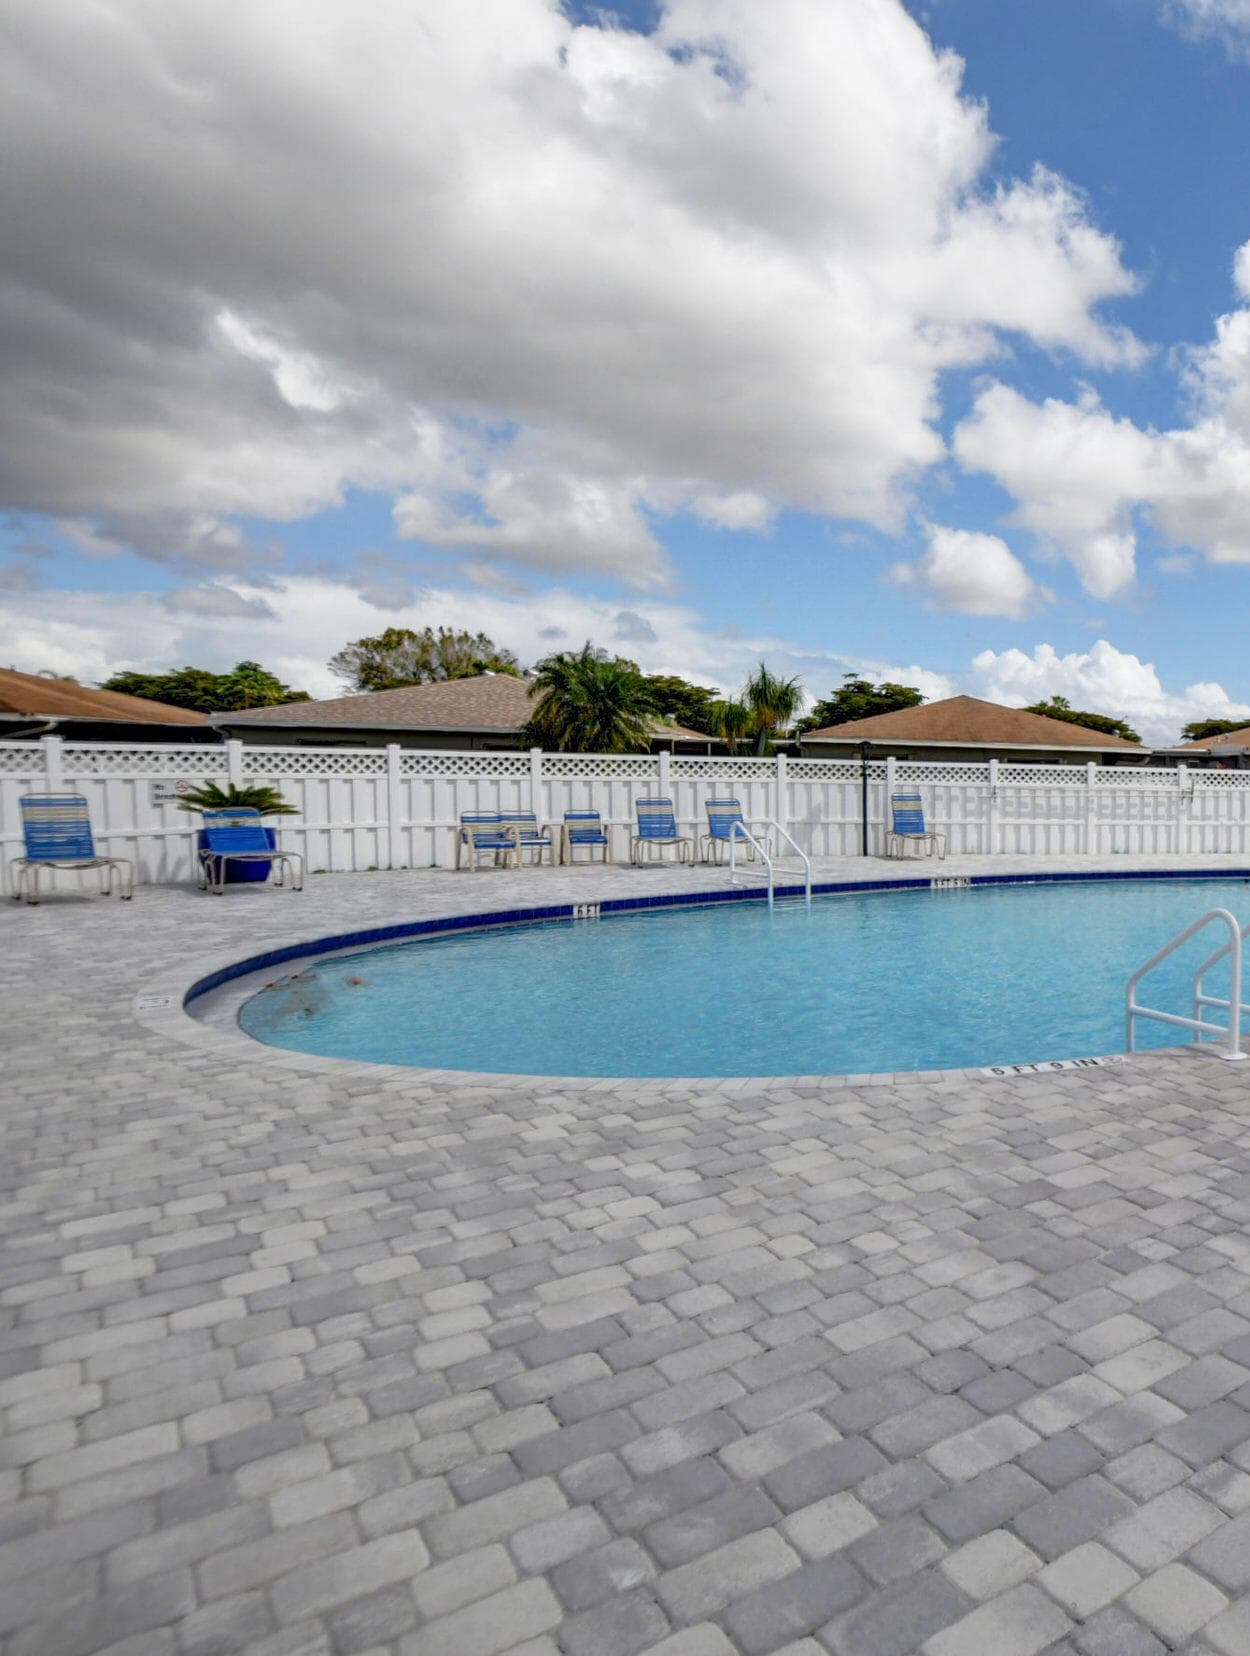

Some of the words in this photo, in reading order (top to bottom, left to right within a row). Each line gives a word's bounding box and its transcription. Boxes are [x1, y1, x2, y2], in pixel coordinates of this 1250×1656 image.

[1012, 1063, 1038, 1074] FT
[1050, 1062, 1064, 1070] 9
[1071, 1058, 1099, 1067] IN
